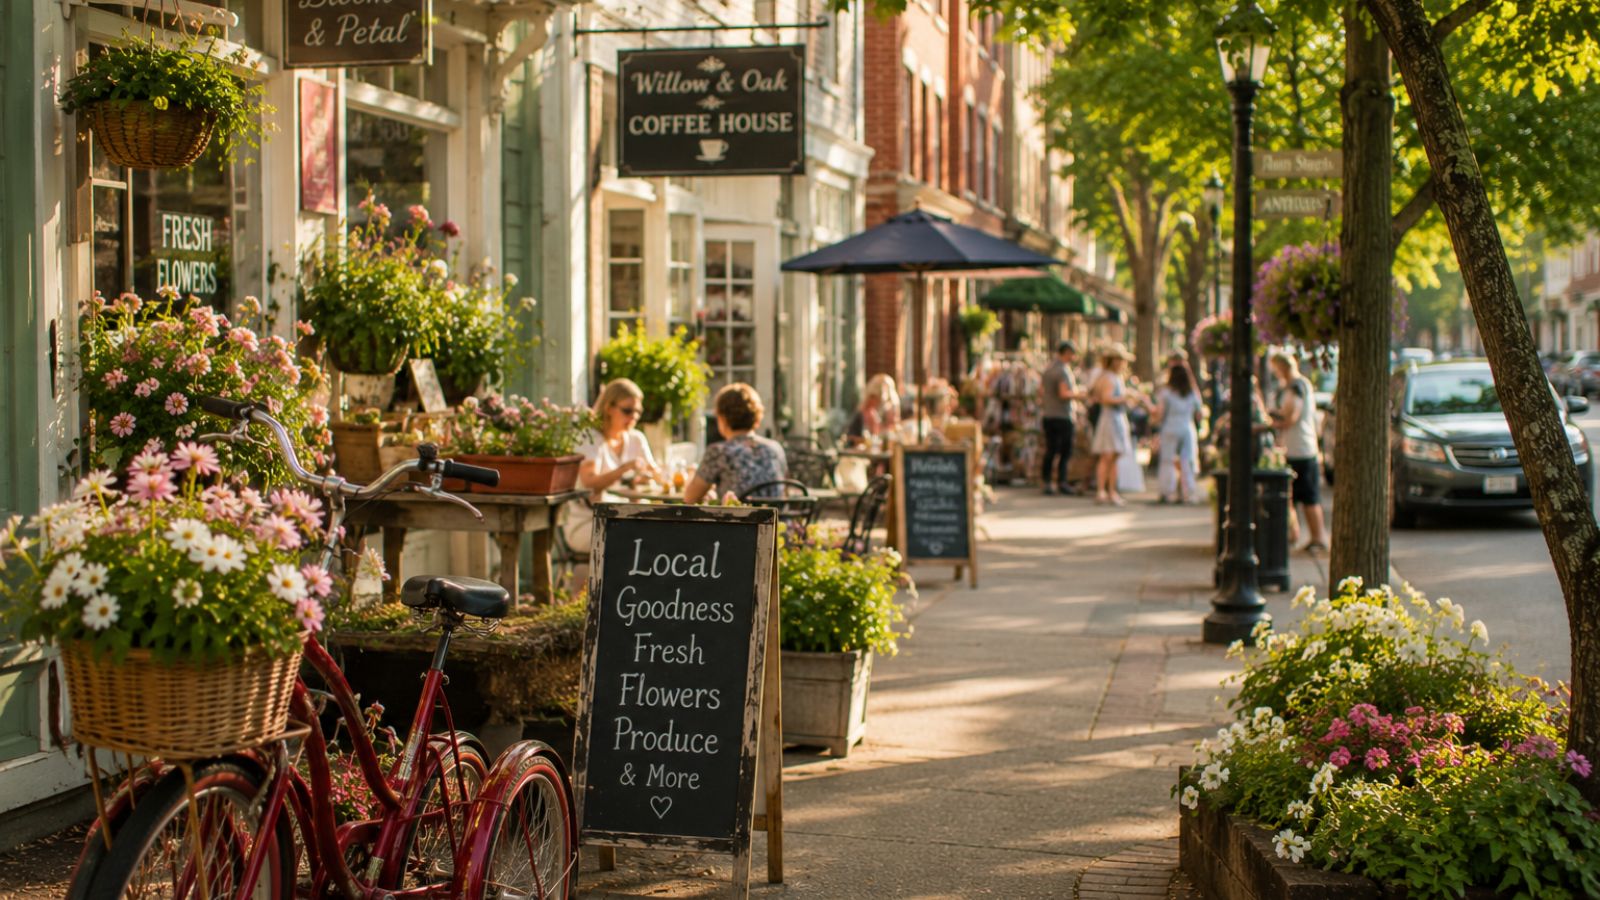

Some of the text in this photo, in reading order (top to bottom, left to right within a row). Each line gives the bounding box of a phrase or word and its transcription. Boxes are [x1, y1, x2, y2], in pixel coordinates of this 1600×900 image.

[304, 11, 410, 46] & Petal
[630, 68, 789, 95] Willow & Oak
[628, 111, 793, 136] COFFEE HOUSE
[161, 213, 212, 252] FRESH
[157, 258, 217, 295] FLOWERS
[628, 538, 722, 579] Local
[615, 585, 735, 626] Goodness
[633, 632, 706, 665] Fresh
[619, 672, 721, 710] Flowers
[613, 716, 719, 754] Produce
[619, 762, 701, 790] & More
